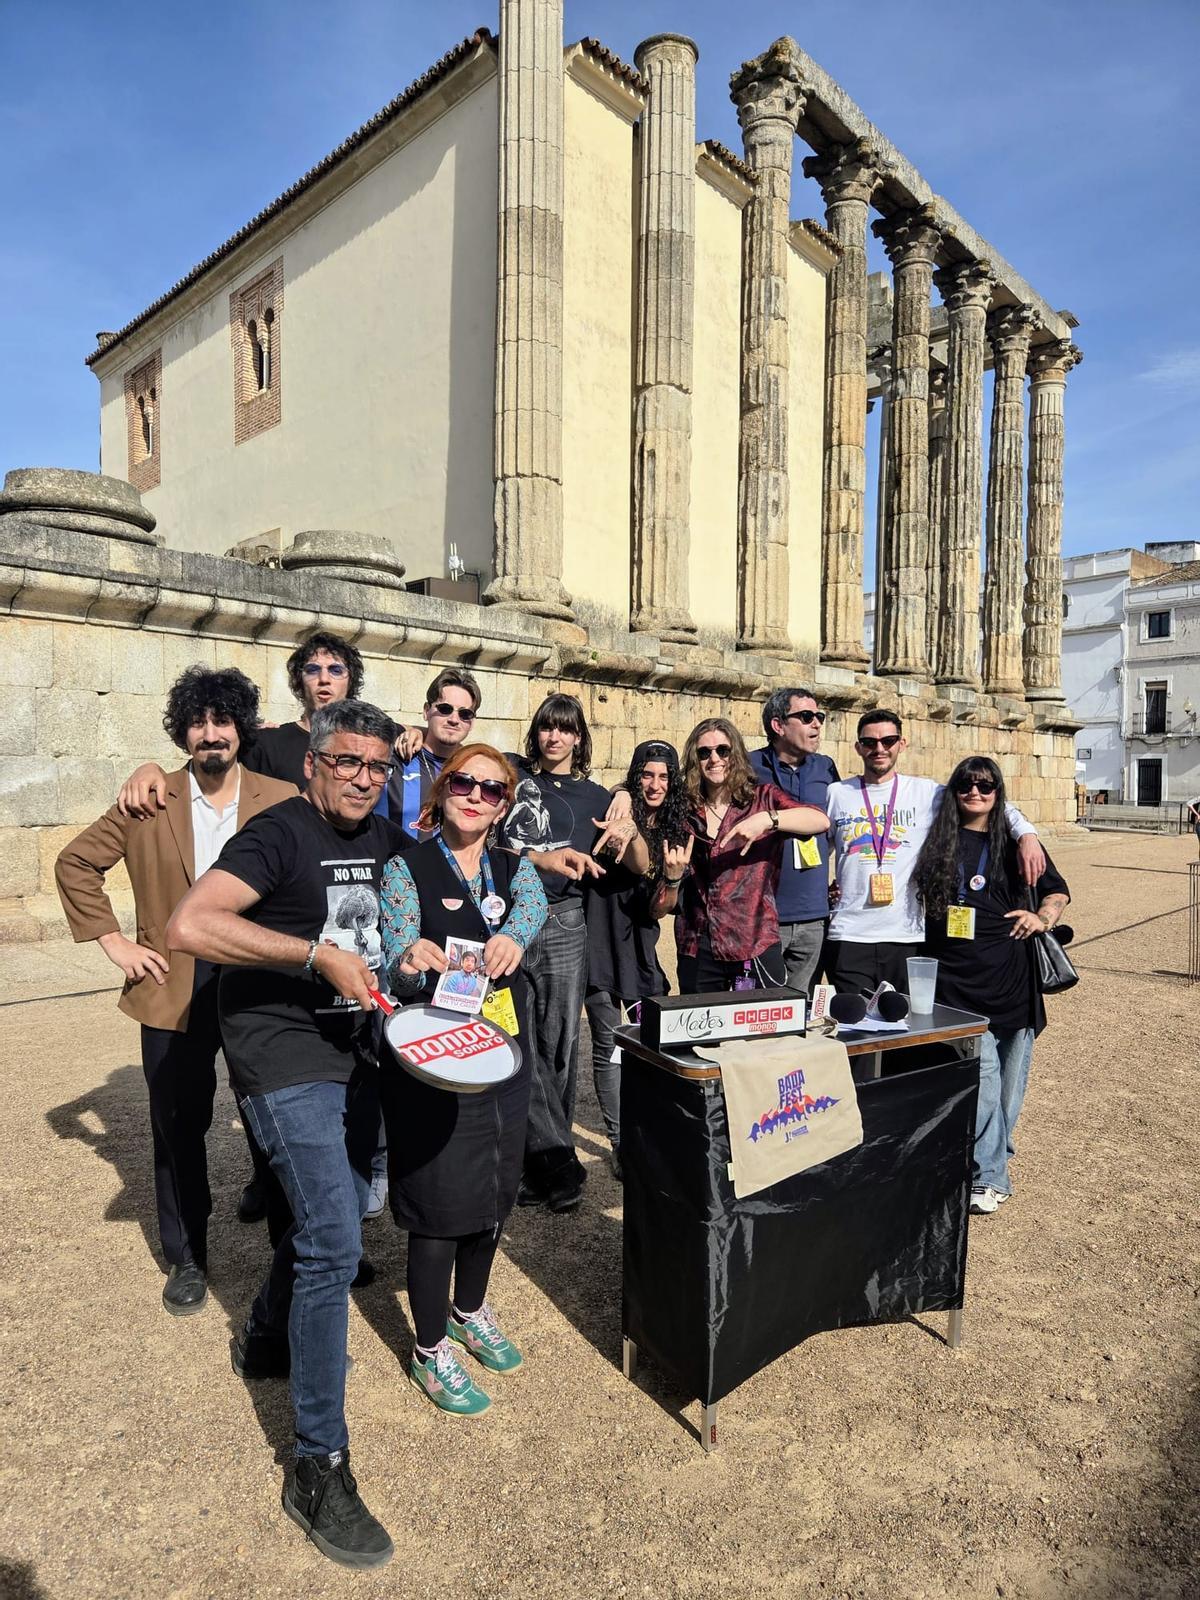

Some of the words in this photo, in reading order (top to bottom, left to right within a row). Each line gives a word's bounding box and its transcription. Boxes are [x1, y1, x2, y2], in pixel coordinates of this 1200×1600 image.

[333, 868, 350, 882] NO
[350, 867, 373, 881] WAR
[734, 1007, 792, 1024] CHECK
[778, 1069, 805, 1095] BADA
[779, 1086, 804, 1109] FEST
